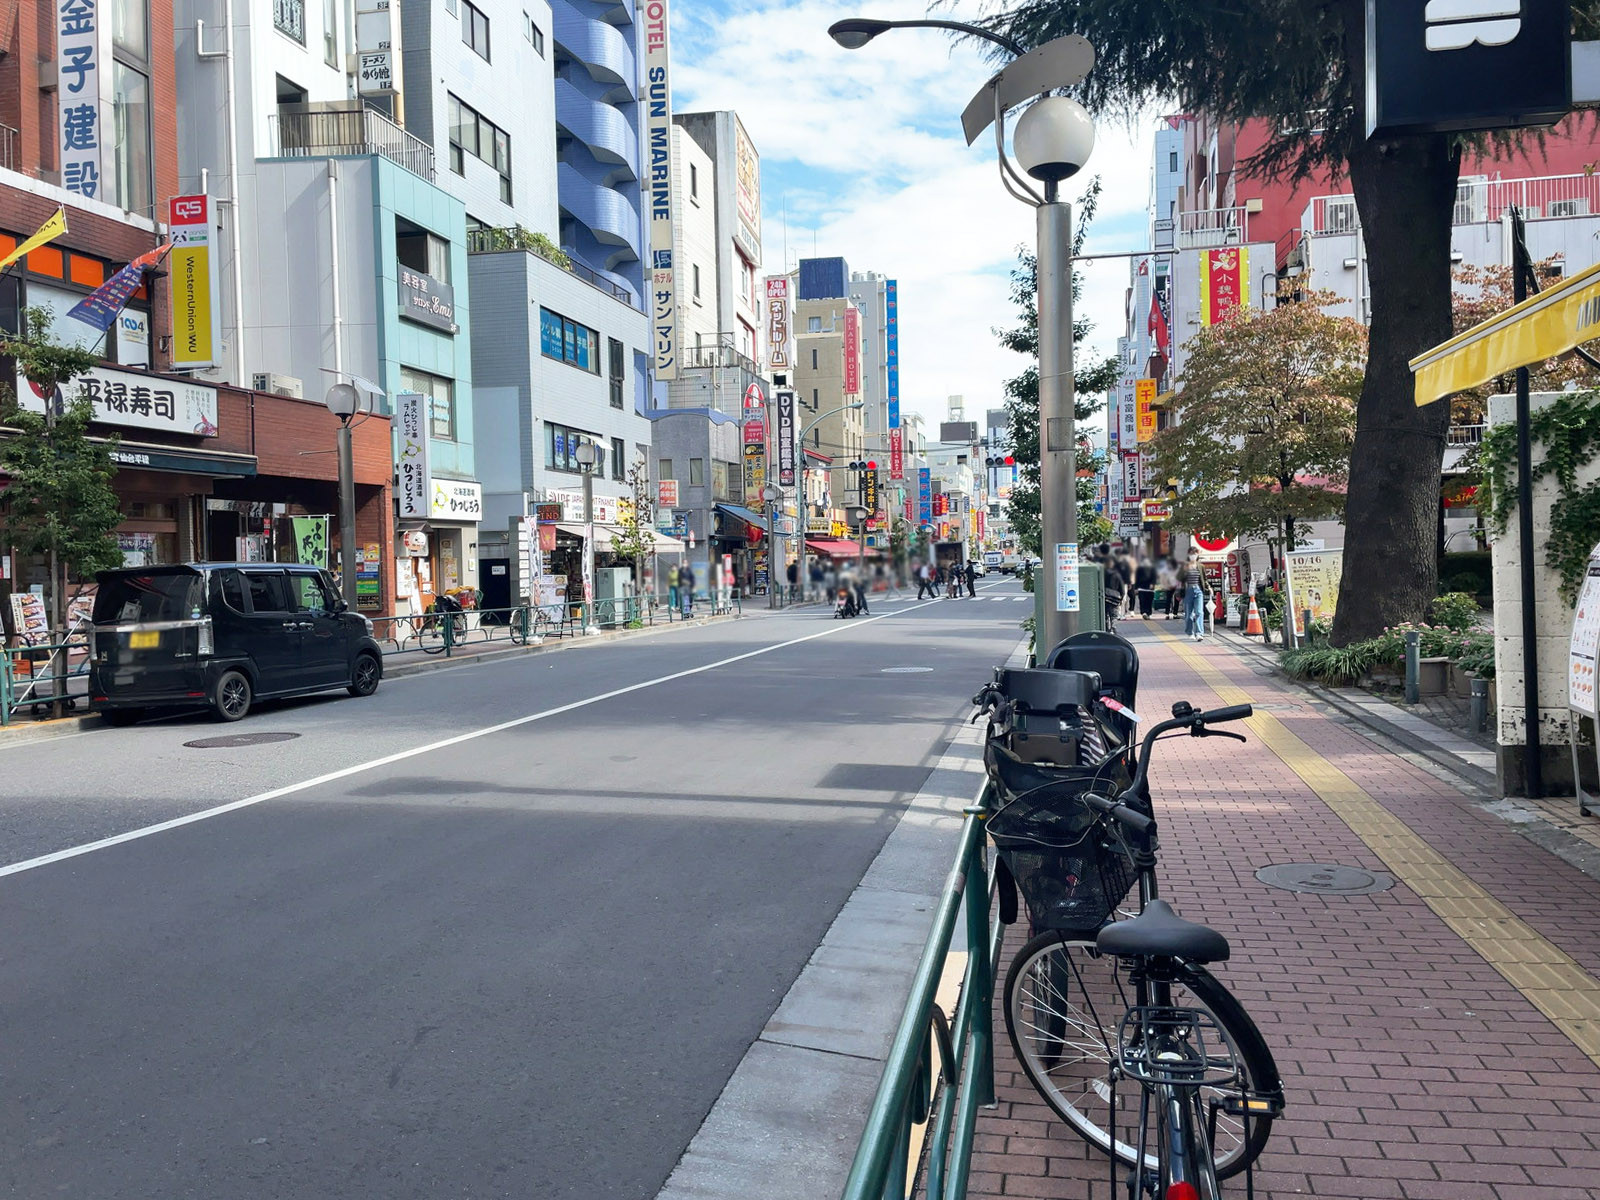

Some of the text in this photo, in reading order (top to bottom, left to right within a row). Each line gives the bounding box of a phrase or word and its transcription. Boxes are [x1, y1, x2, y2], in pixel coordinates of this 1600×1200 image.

[362, 56, 385, 66] ラーメン
[61, 0, 98, 198] 金子建設
[647, 0, 670, 220] OTEL SUN MARINE
[403, 271, 428, 293] 美容室
[654, 273, 672, 284] ホテル
[769, 281, 784, 289] 24h
[768, 288, 786, 297] OPEN
[848, 357, 856, 390] HOTEL
[450, 498, 480, 513] ひつじろう
[1292, 556, 1321, 566] 10/16
